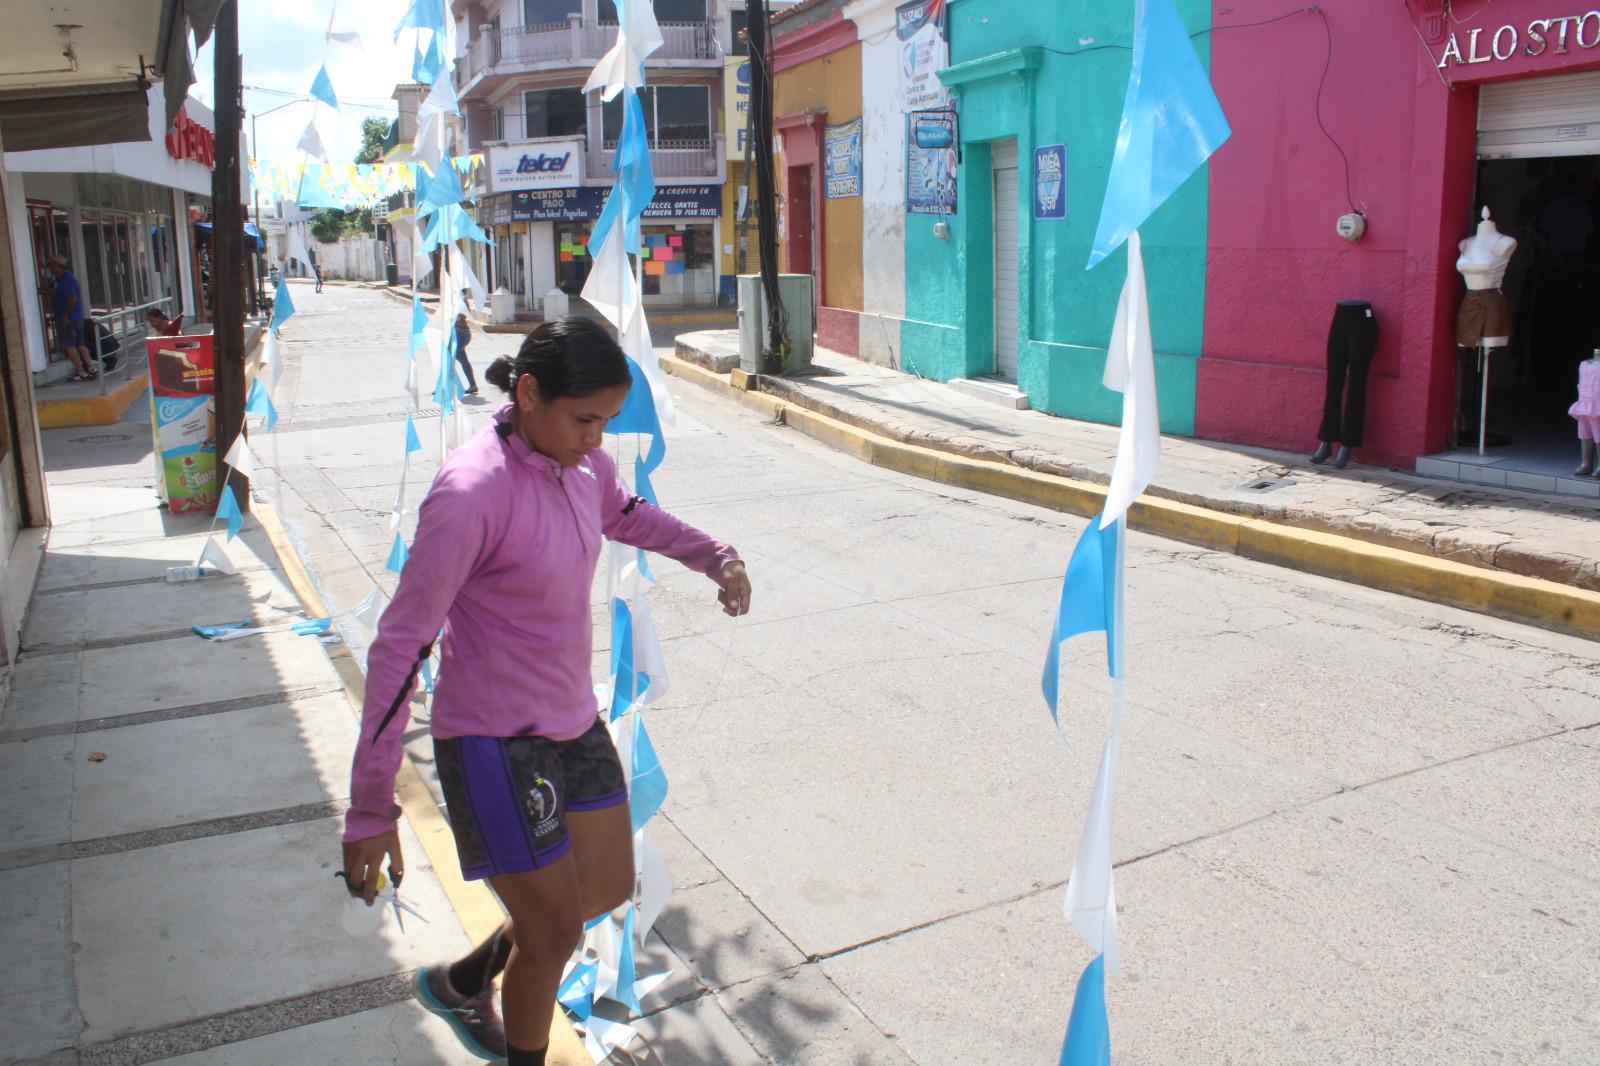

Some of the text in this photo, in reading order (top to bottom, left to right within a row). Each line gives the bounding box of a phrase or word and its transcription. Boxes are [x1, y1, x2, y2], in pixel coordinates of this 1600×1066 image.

[516, 152, 571, 174] telcel
[532, 189, 578, 200] CENTRO DE
[666, 187, 697, 195] CREDITO
[543, 199, 564, 208] PAGO
[674, 201, 699, 209] GRATIS
[643, 209, 672, 217] RENUEVA
[699, 208, 717, 216] TELCEL
